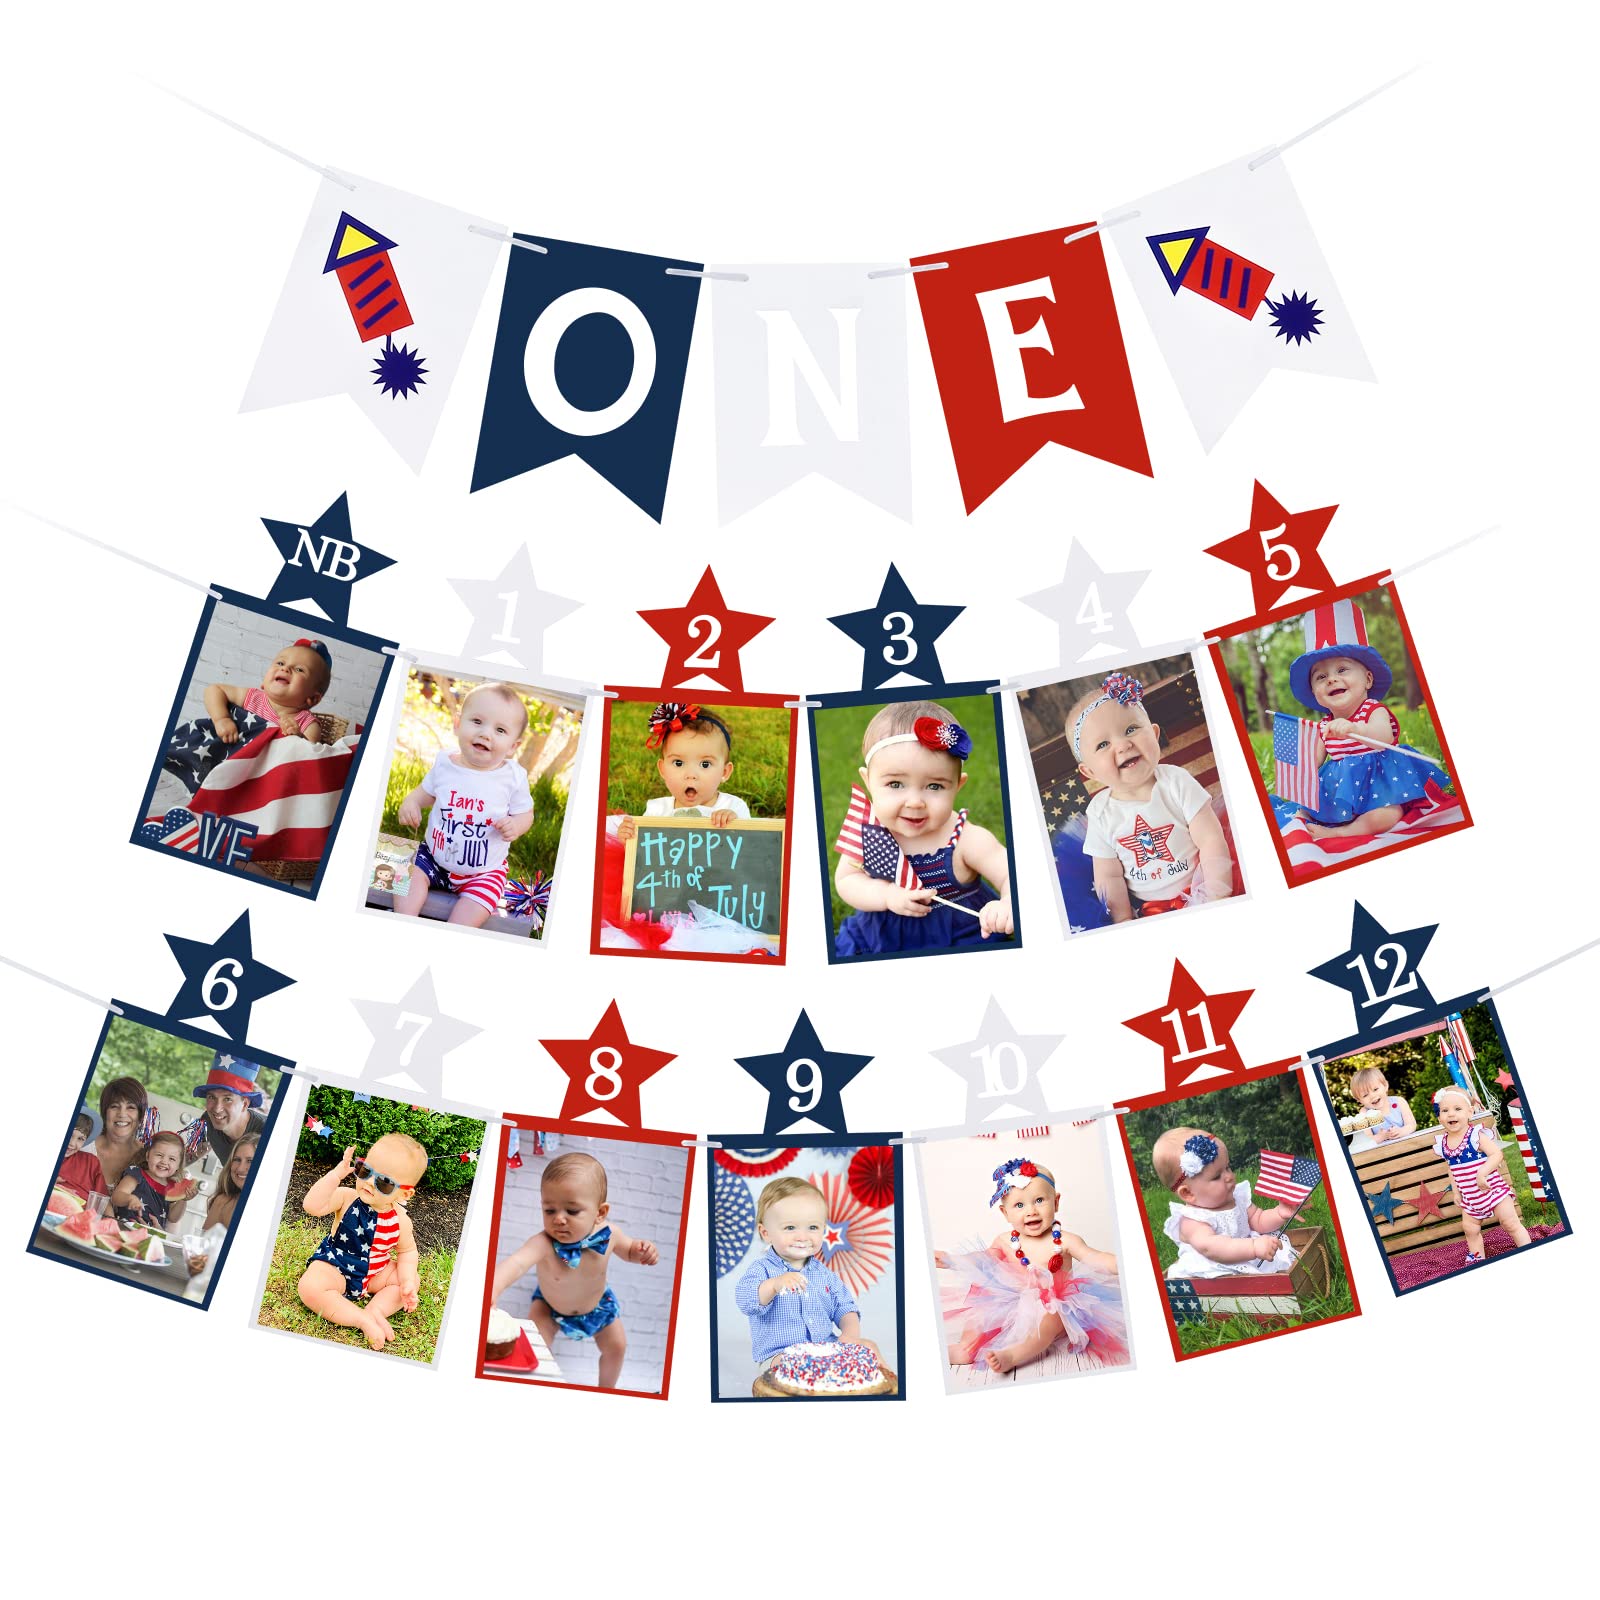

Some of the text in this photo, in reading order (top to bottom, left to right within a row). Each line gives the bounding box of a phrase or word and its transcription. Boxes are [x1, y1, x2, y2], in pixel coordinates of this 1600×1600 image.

[288, 528, 361, 582] NB
[1259, 522, 1301, 581] 5
[491, 590, 521, 644] 1
[1076, 581, 1114, 634] 4
[684, 614, 722, 668] 2
[882, 611, 918, 665] 3
[440, 808, 488, 839] First
[448, 790, 485, 813] Ian's
[457, 839, 489, 868] JULY
[641, 831, 743, 870] Happy
[1129, 859, 1189, 881] 4th of July
[636, 865, 705, 908] 4th of
[708, 883, 766, 929] July
[201, 957, 244, 1011] 6
[1345, 942, 1419, 1009] 12
[395, 1010, 433, 1067] 7
[1160, 1001, 1227, 1064] 11
[584, 1046, 623, 1101] 8
[786, 1058, 823, 1112] 9
[970, 1041, 1028, 1098] 10
